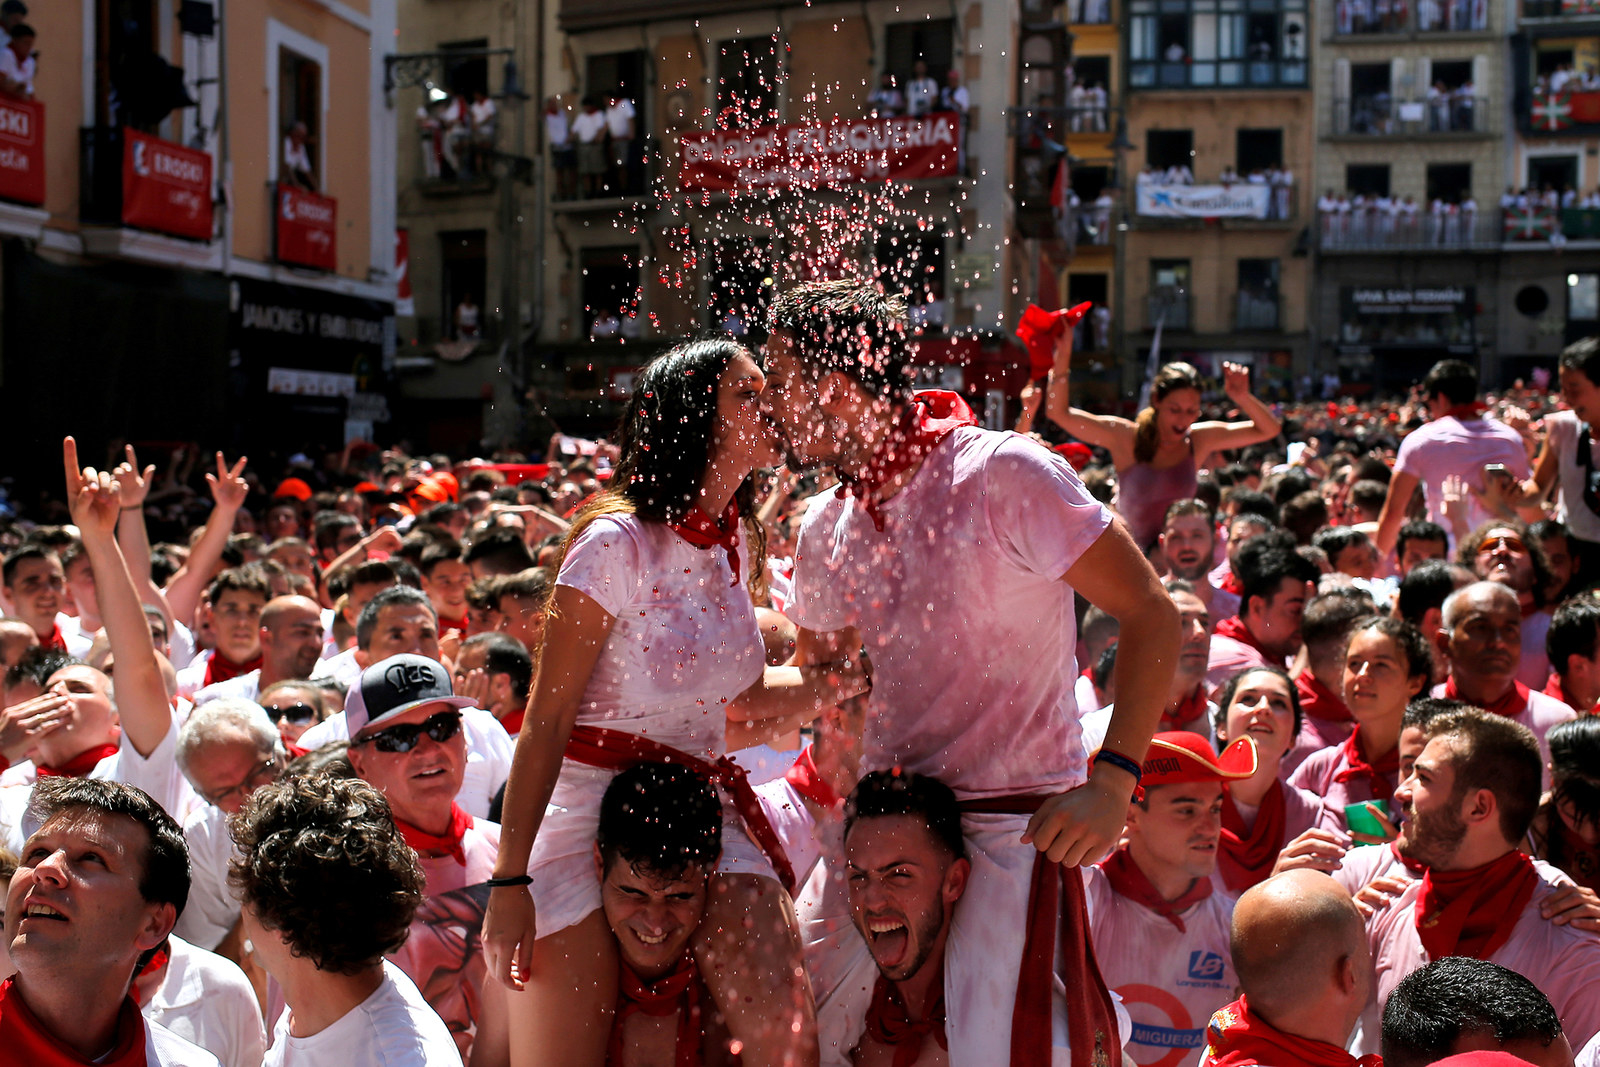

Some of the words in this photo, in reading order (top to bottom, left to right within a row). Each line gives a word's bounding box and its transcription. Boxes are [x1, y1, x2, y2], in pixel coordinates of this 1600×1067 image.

[154, 152, 204, 183] EROSKI
[242, 303, 304, 335] JAMONES
[306, 312, 318, 335] Y
[1142, 757, 1182, 776] organ
[1134, 1029, 1202, 1046] MIGUERA
